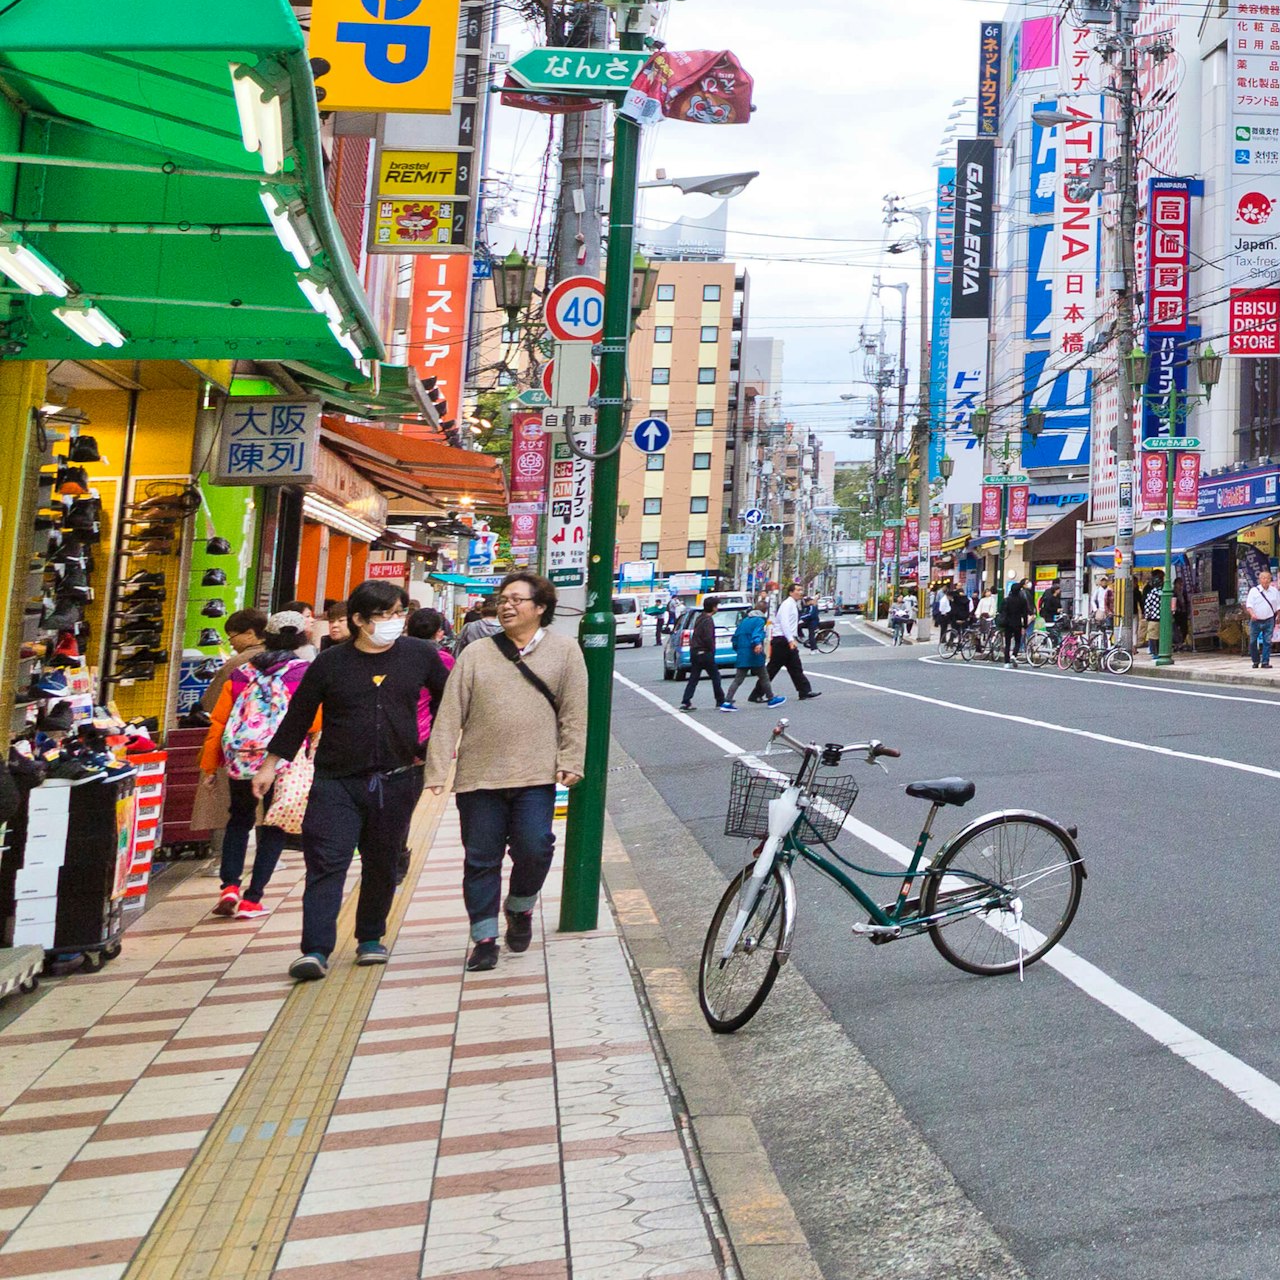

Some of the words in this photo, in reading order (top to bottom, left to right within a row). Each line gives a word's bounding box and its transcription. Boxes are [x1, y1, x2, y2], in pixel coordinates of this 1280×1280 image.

[1238, 4, 1280, 16] 美容機器
[985, 26, 999, 37] 6F
[1238, 39, 1280, 51] 日用品
[1072, 28, 1089, 91] アテナ
[981, 38, 999, 117] ネットカフェ
[1237, 77, 1280, 89] 電化製品
[1237, 95, 1279, 107] ブランド品
[461, 117, 471, 133] 4
[389, 161, 430, 171] brastel
[459, 166, 468, 181] 3
[385, 169, 452, 184] REMIT
[1154, 181, 1188, 190] JANPARA
[454, 215, 463, 232] 2
[962, 163, 984, 296] GALLERIA
[1234, 238, 1278, 253] Japan.
[1154, 197, 1186, 326] 高価買取
[1234, 255, 1277, 267] Tax-free
[1250, 267, 1277, 280] Shop
[563, 297, 601, 327] 40
[1062, 274, 1084, 354] 日本橋
[1234, 302, 1277, 315] EBISU
[1234, 318, 1277, 333] DRUG
[1233, 334, 1276, 349] STORE
[231, 405, 307, 436] 大阪
[228, 442, 304, 473] 陳列
[554, 463, 573, 477] たばこ
[554, 483, 572, 496] ATM
[554, 503, 572, 516] カフェ
